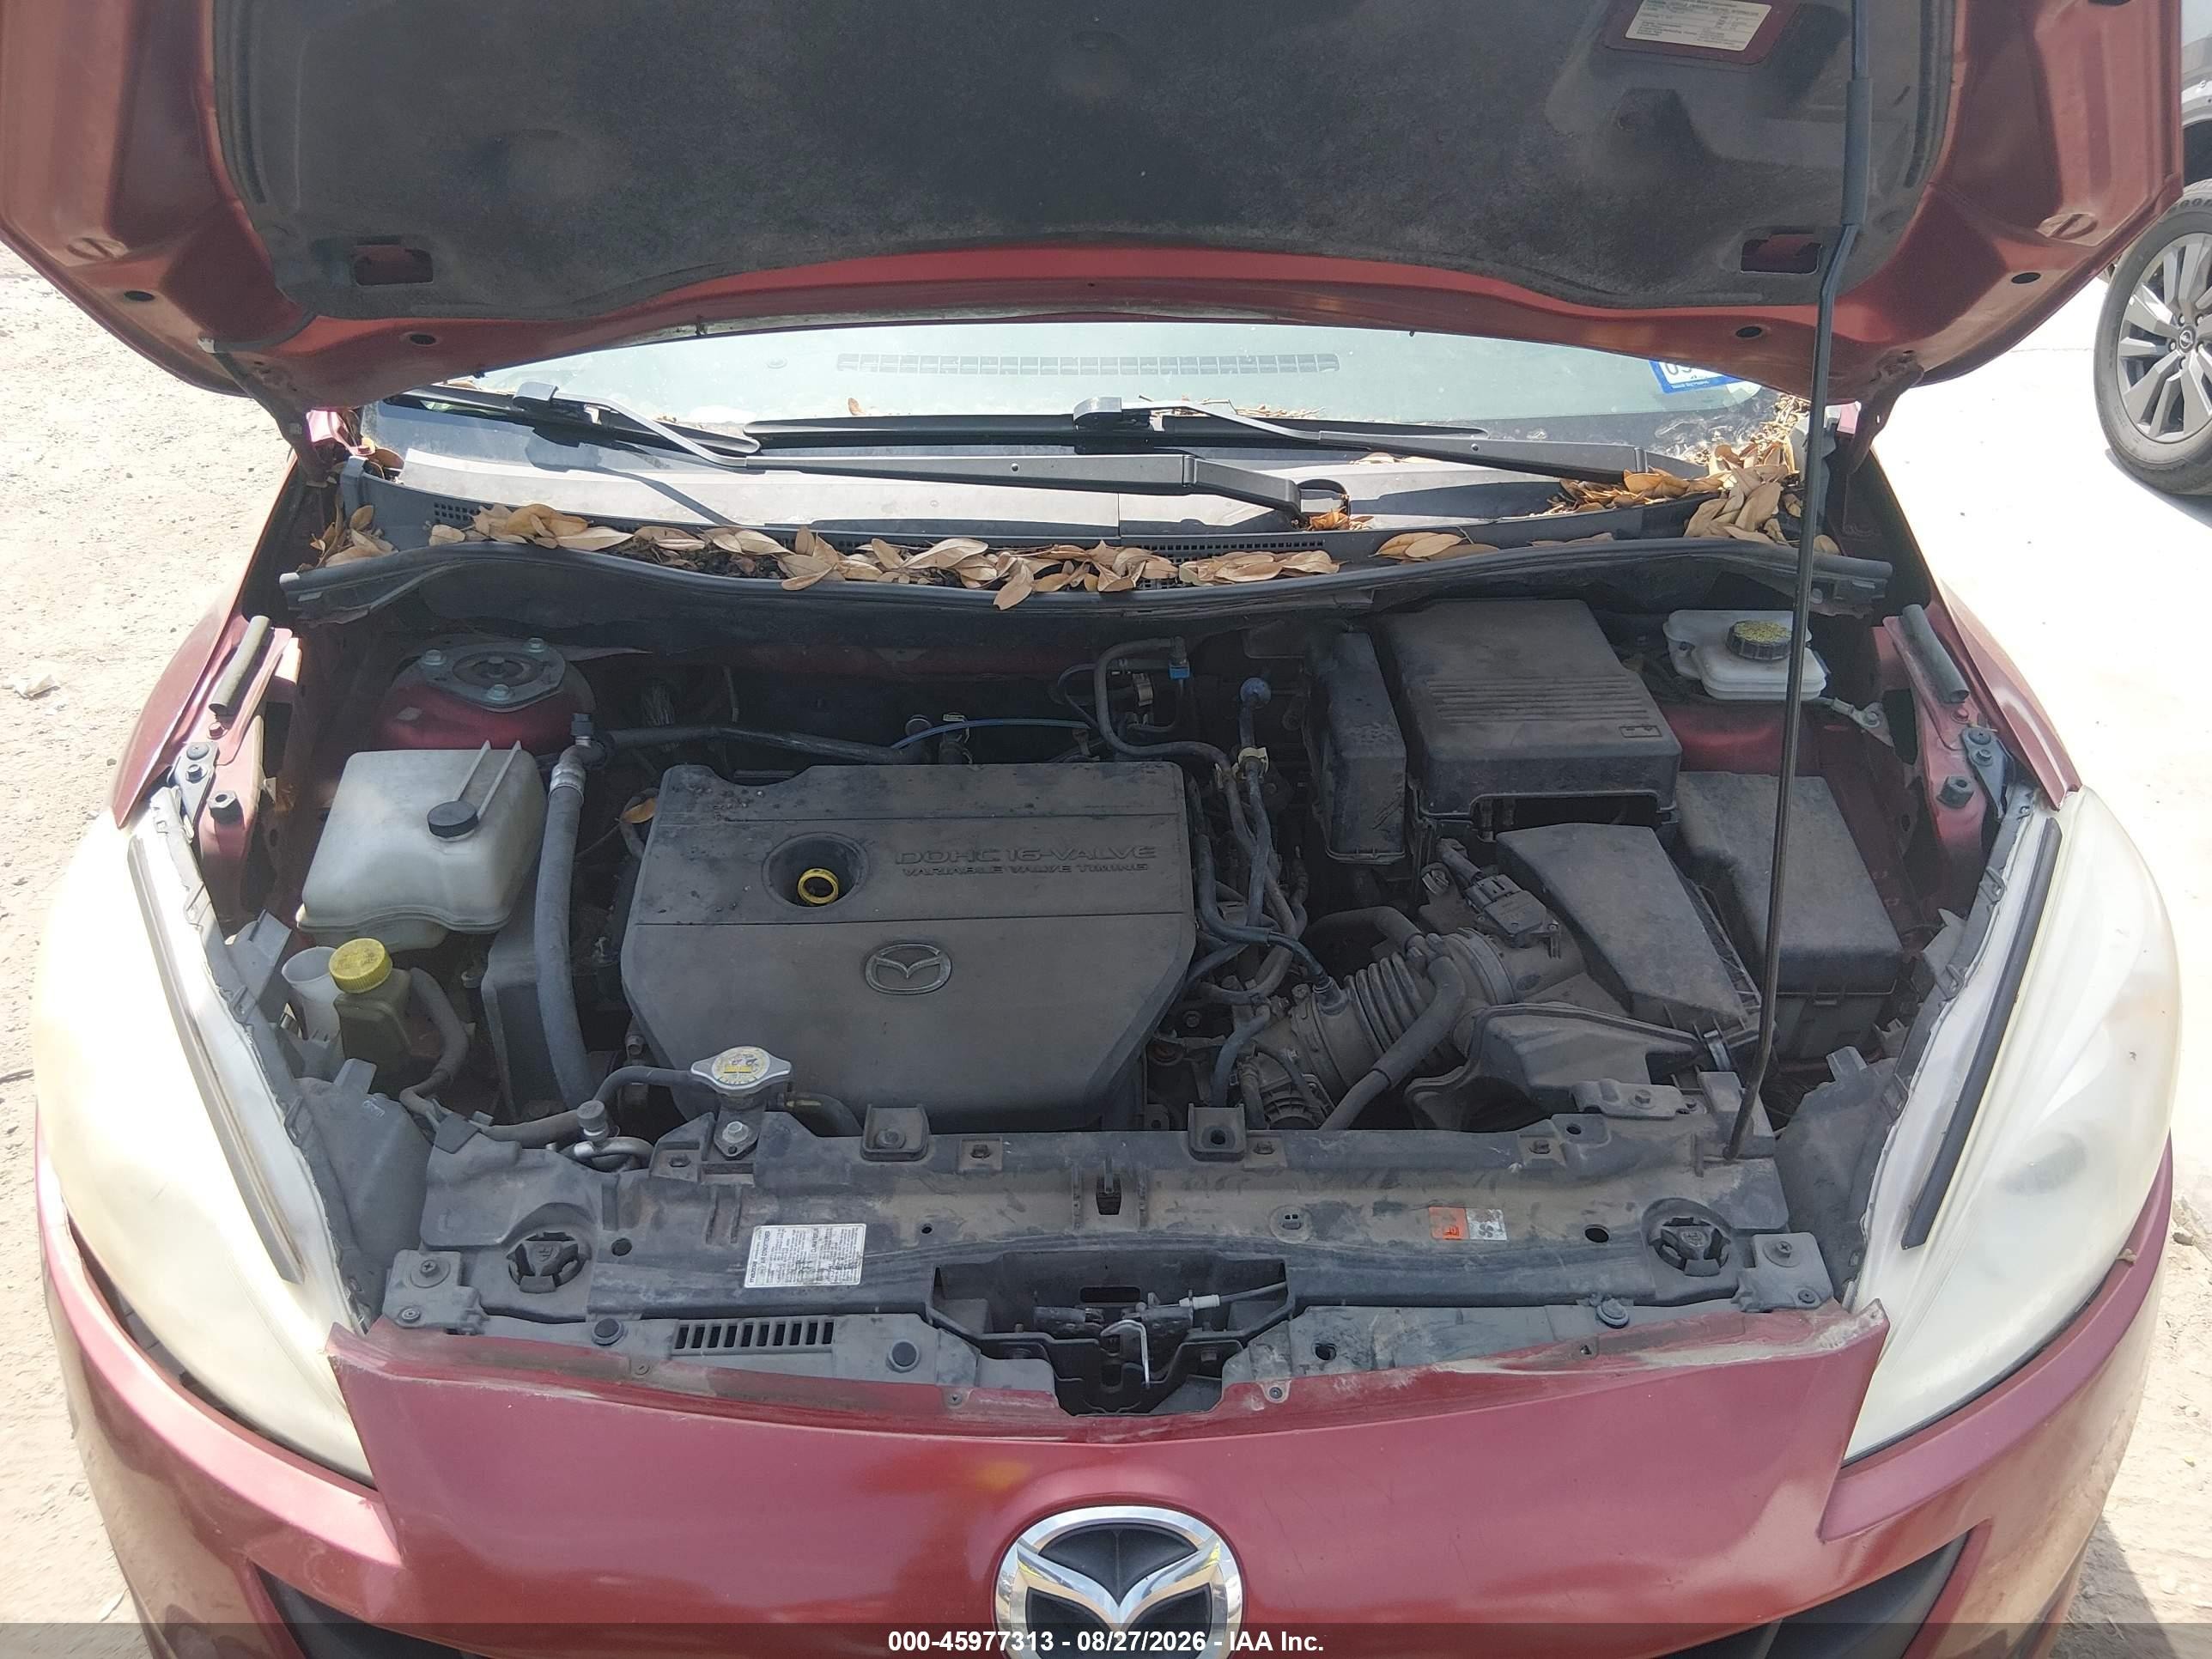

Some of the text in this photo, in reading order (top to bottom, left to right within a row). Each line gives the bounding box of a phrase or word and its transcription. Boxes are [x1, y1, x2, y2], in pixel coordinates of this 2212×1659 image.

[896, 846, 1157, 865] DOHC 16-VALVE
[902, 862, 1149, 877] VARIABLE VALVE TIMING
